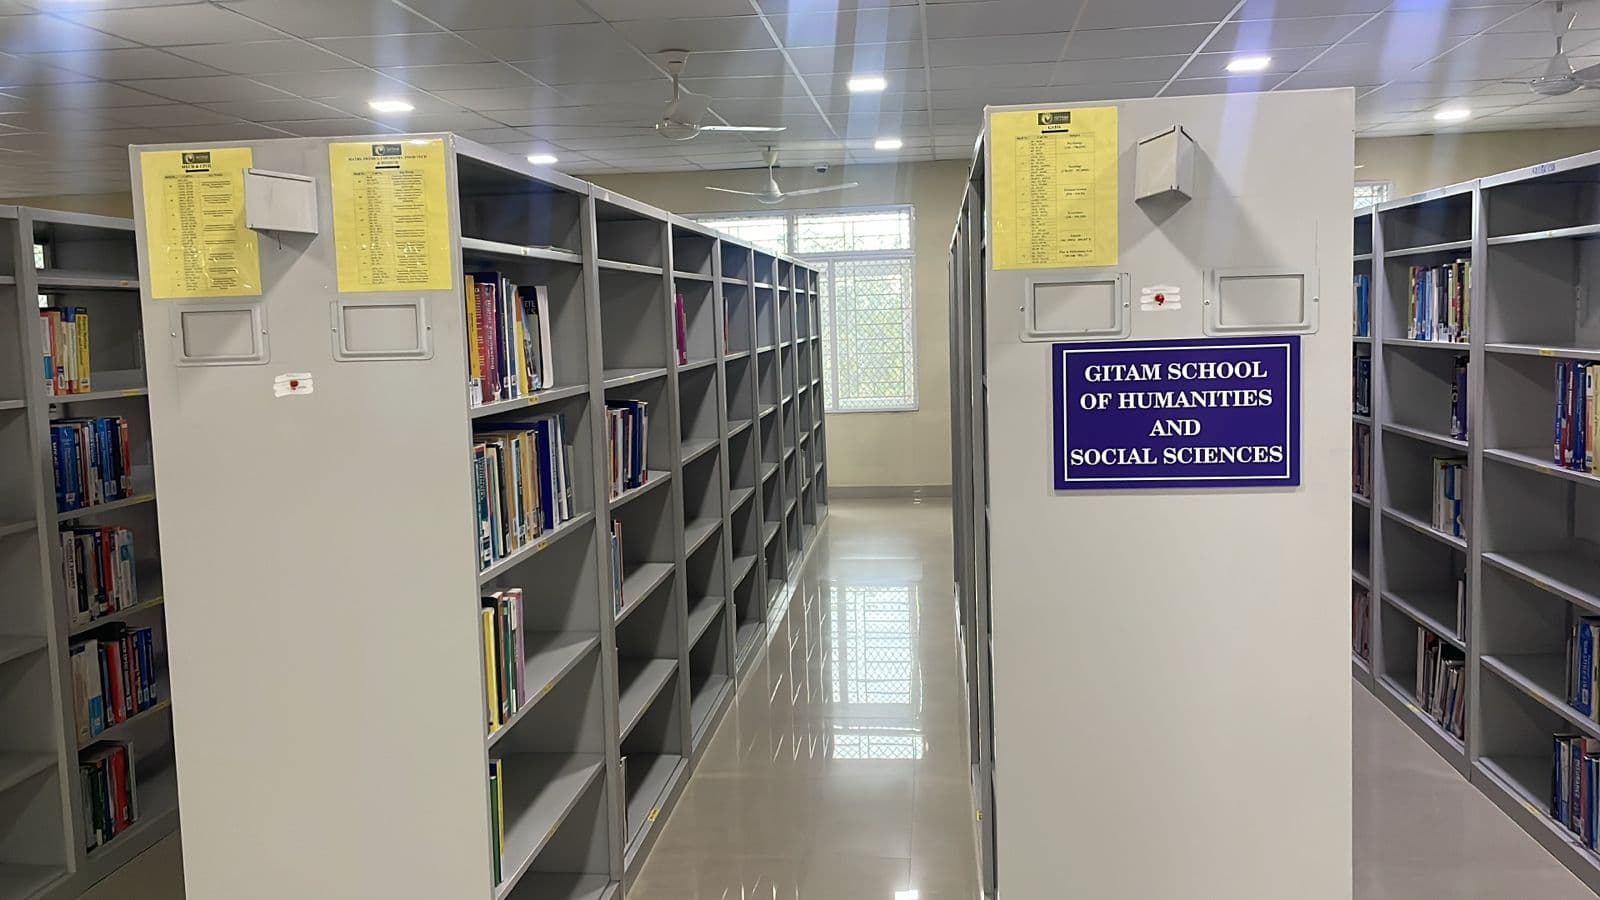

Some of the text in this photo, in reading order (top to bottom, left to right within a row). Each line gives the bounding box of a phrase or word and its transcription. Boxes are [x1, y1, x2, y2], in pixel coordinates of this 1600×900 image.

[1084, 361, 1268, 382] GITAM SCHOOL
[1079, 389, 1273, 410] OF HUMANITIES
[1149, 419, 1201, 437] AND
[1070, 446, 1284, 466] SOCIAL SCIENCES
